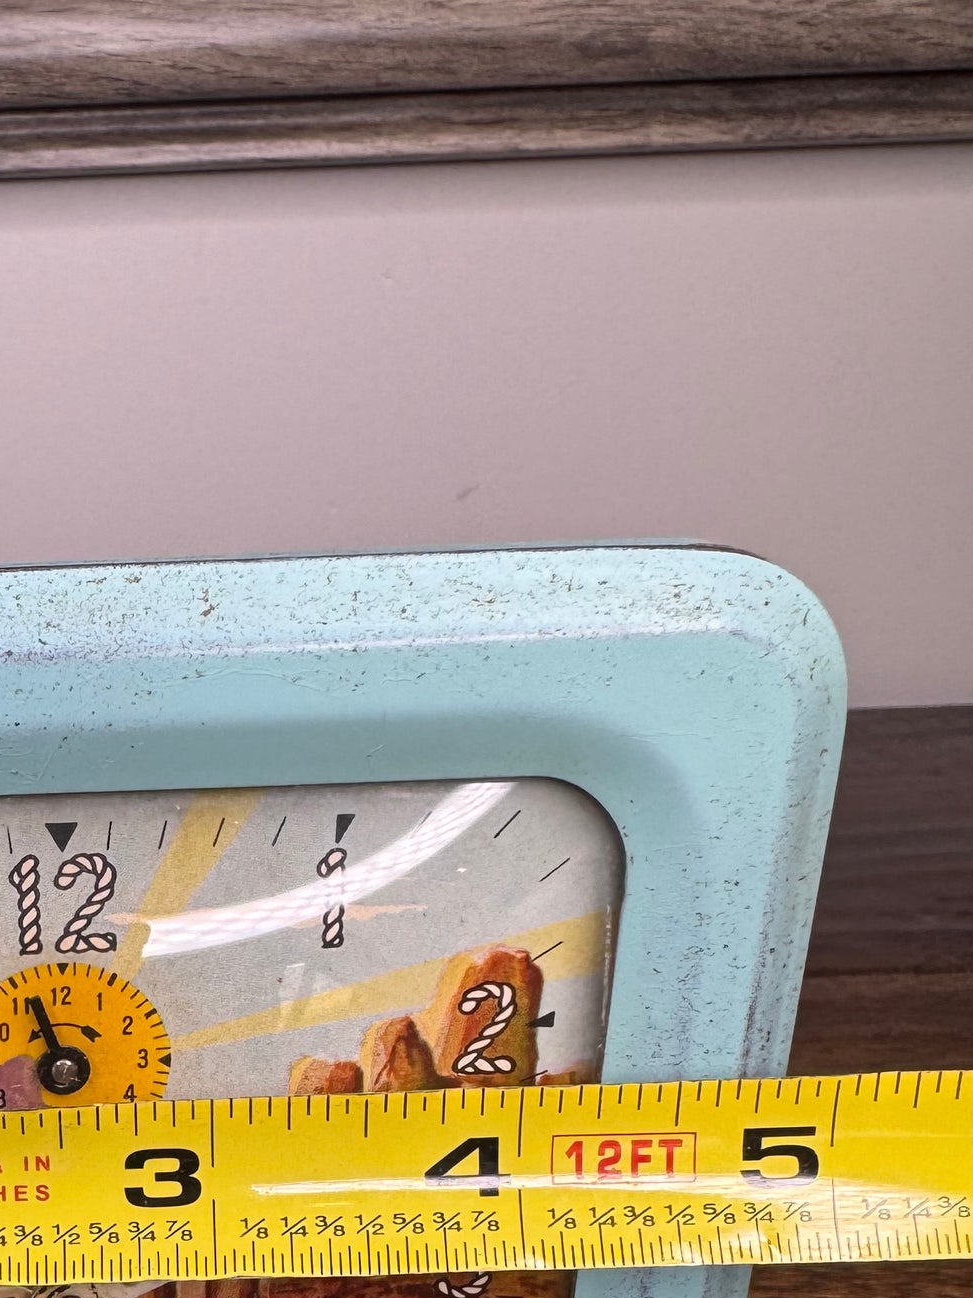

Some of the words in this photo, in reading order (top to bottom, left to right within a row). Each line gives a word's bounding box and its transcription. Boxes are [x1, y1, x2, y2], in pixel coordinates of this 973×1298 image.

[8, 853, 117, 955] 12
[316, 847, 348, 949] 1
[12, 997, 30, 1015] 11
[50, 986, 72, 1006] 12
[96, 992, 103, 1011] 1
[122, 1015, 134, 1036] 2
[452, 980, 517, 1075] 2
[137, 1049, 149, 1069] 3
[123, 1083, 137, 1103] 4
[23, 1155, 51, 1172] IN
[124, 1148, 202, 1208] 3
[424, 1136, 512, 1197] 4
[564, 1138, 684, 1182] 12FT
[739, 1126, 820, 1188] 5
[13, 1225, 43, 1246] 3/8
[51, 1224, 81, 1244] 1/2
[89, 1223, 120, 1244] 5/8
[128, 1221, 156, 1242] 3/4
[165, 1220, 193, 1241] 7/8
[240, 1217, 268, 1239] 1/8
[280, 1217, 308, 1236] 1/4
[315, 1215, 346, 1236] 3/8
[354, 1214, 385, 1235] 1/2
[392, 1213, 425, 1234] 5/8
[432, 1212, 463, 1231] 3/4
[470, 1210, 500, 1231] 7/8
[547, 1208, 576, 1229] 1/8
[588, 1207, 617, 1227] 1/4
[623, 1205, 655, 1227] 3/8
[664, 1204, 695, 1225] 1/2
[703, 1203, 736, 1224] 5/8
[743, 1202, 774, 1222] 3/4
[938, 1196, 971, 1217] 3/8
